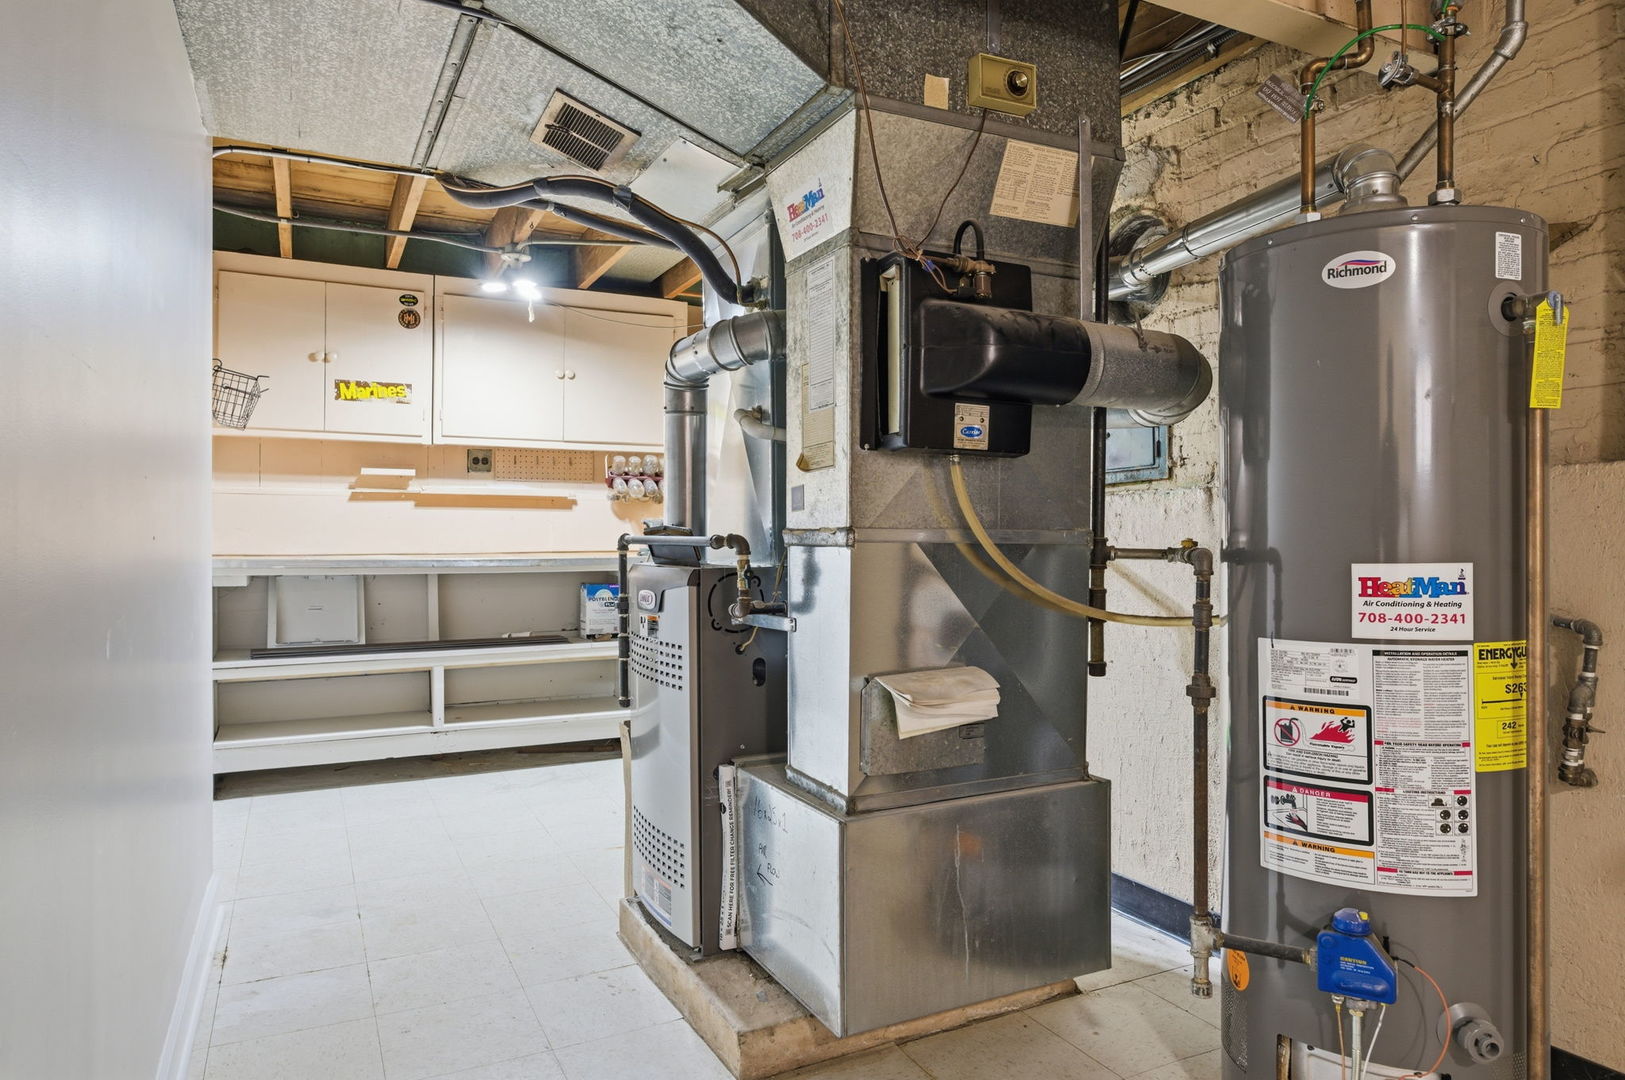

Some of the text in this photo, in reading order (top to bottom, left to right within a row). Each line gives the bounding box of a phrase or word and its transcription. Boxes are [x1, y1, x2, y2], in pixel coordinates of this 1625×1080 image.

[1327, 260, 1387, 279] Richmond
[339, 382, 407, 400] Marines
[1358, 577, 1467, 598] HeatMan
[1375, 600, 1425, 608] Conditioning
[1358, 612, 1466, 624] 708-400-2341
[1297, 706, 1336, 715] WARNING
[1502, 721, 1517, 730] 242
[1299, 788, 1331, 798] DANGER
[1301, 841, 1336, 853] WARNING
